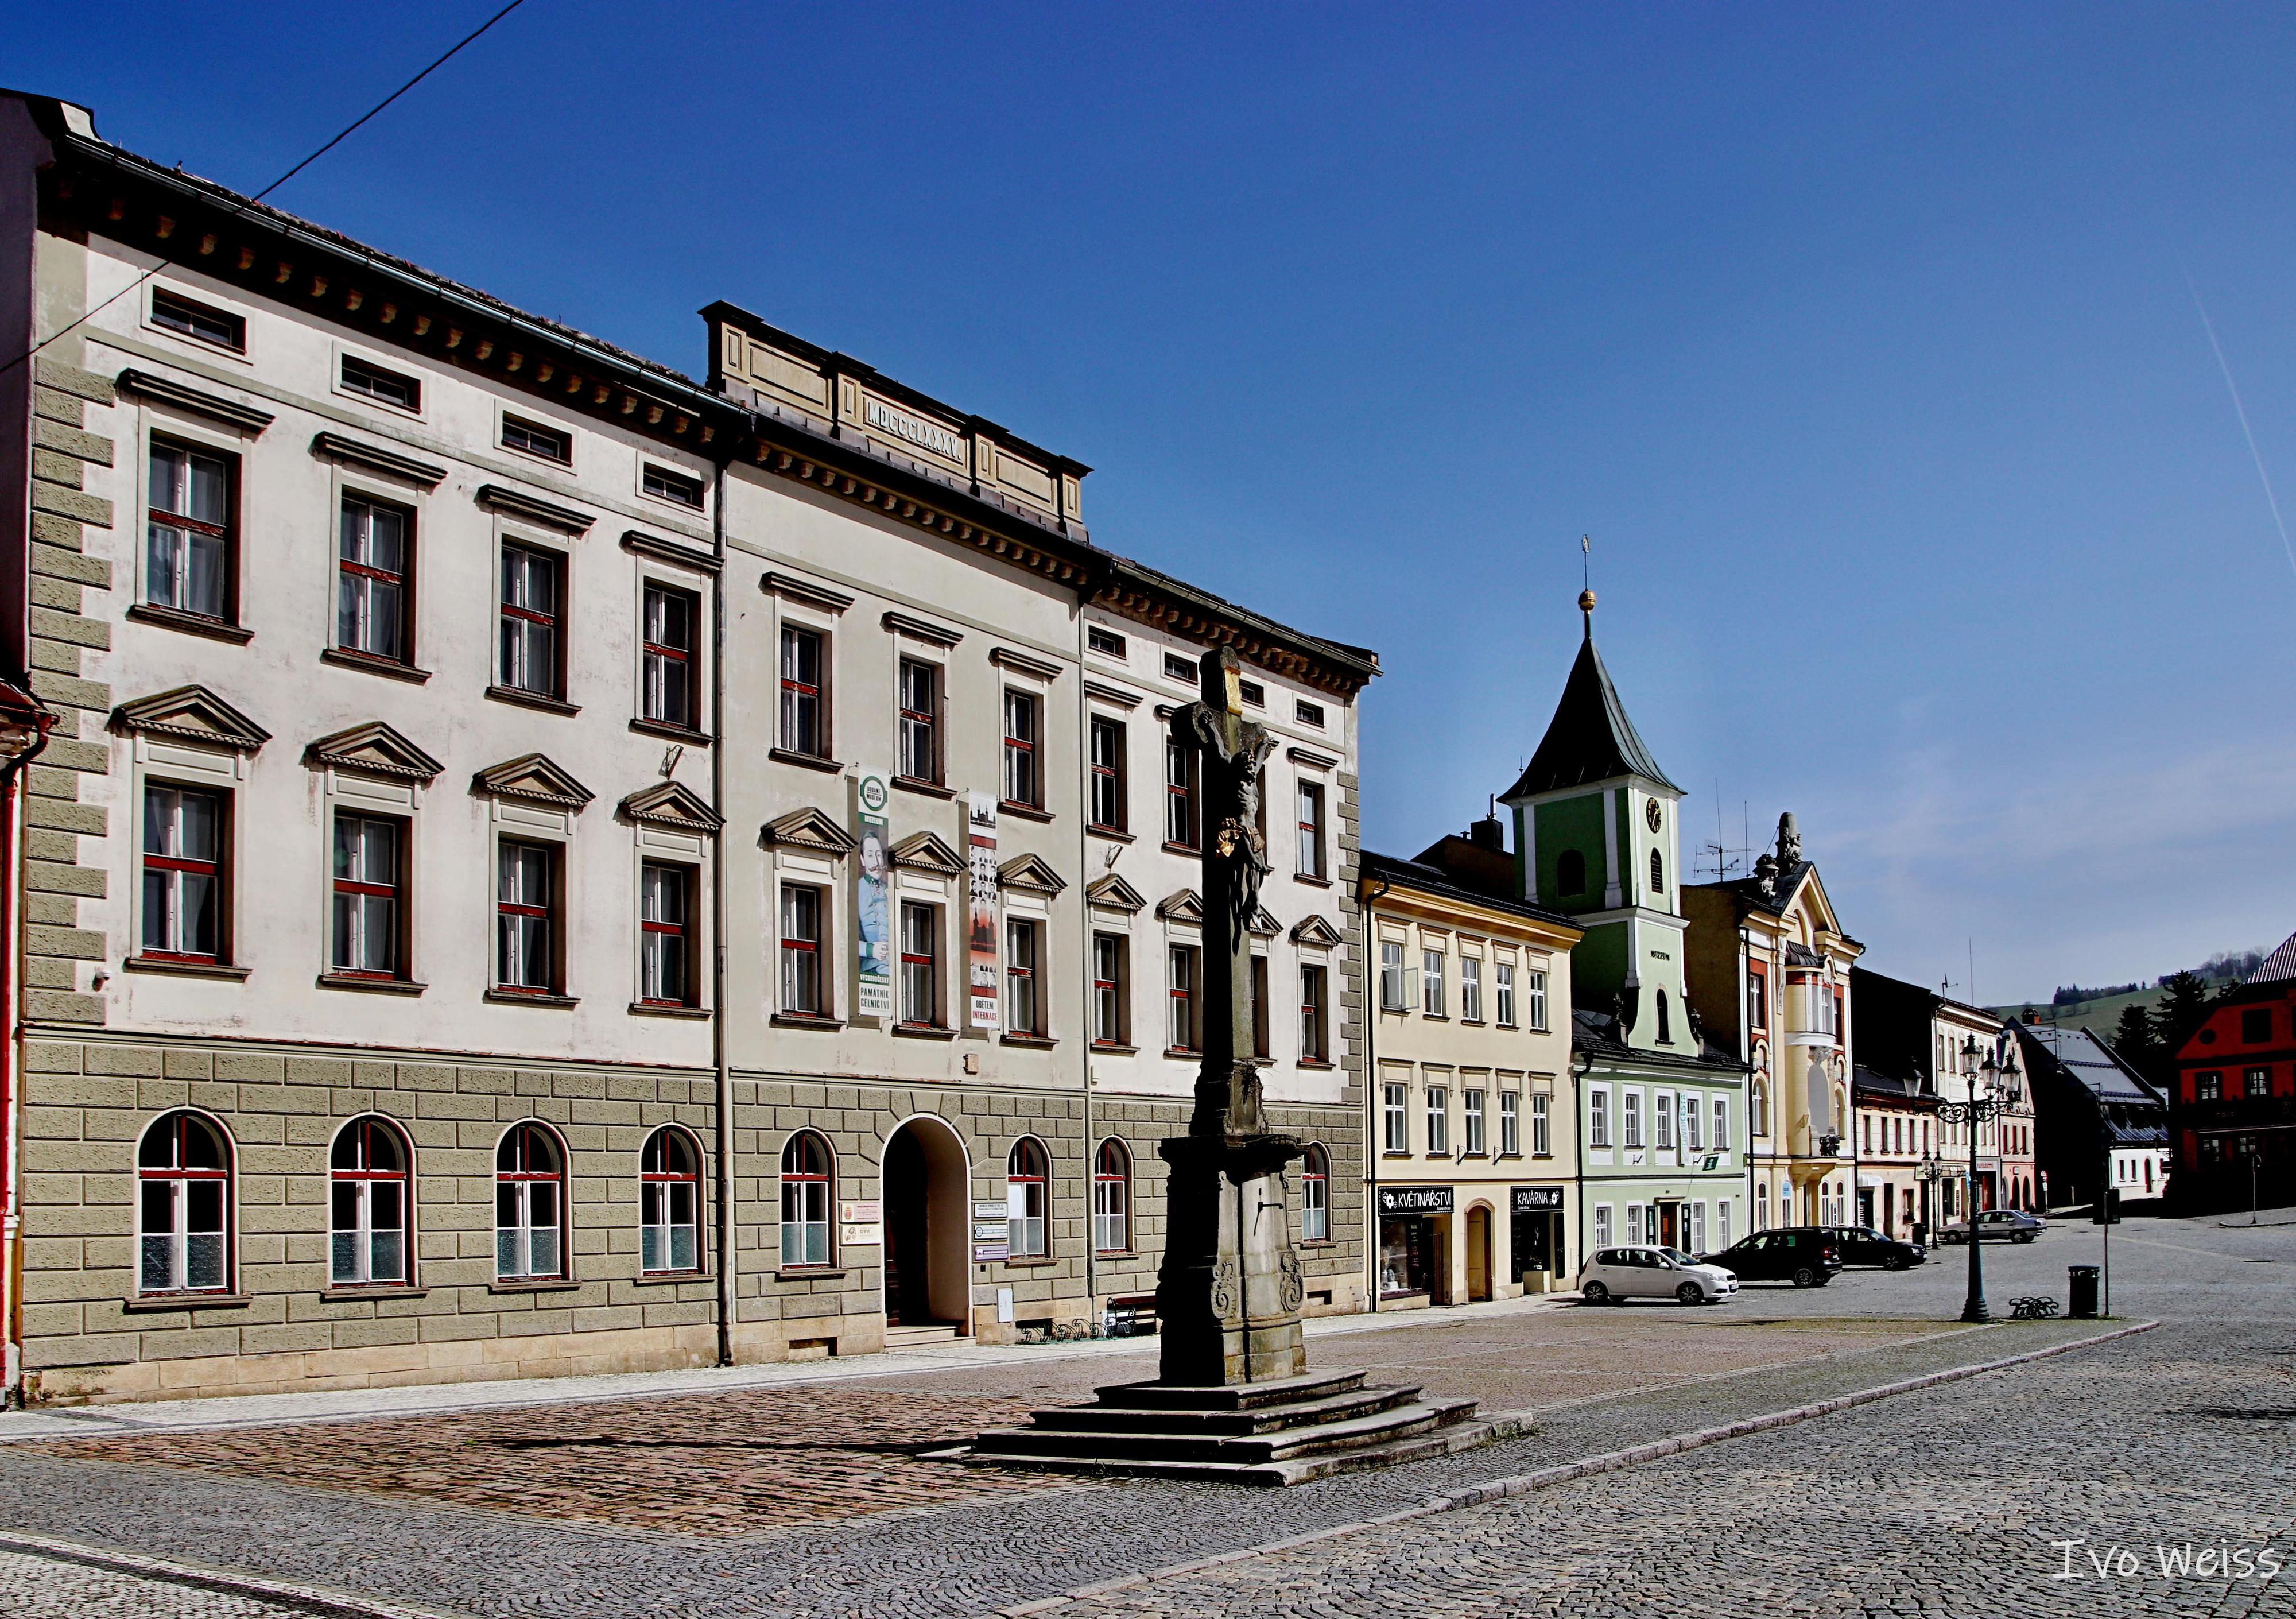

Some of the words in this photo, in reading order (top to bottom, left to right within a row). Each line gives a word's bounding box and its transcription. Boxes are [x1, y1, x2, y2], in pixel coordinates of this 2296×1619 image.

[860, 987, 889, 998] PAMÁTNÍK
[976, 999, 994, 1009] OBĚTEM
[972, 1011, 998, 1021] INTERNACE
[1398, 1190, 1451, 1207] KVĚTINÁŘSTVÍ
[1517, 1190, 1548, 1205] KAVÁRNA
